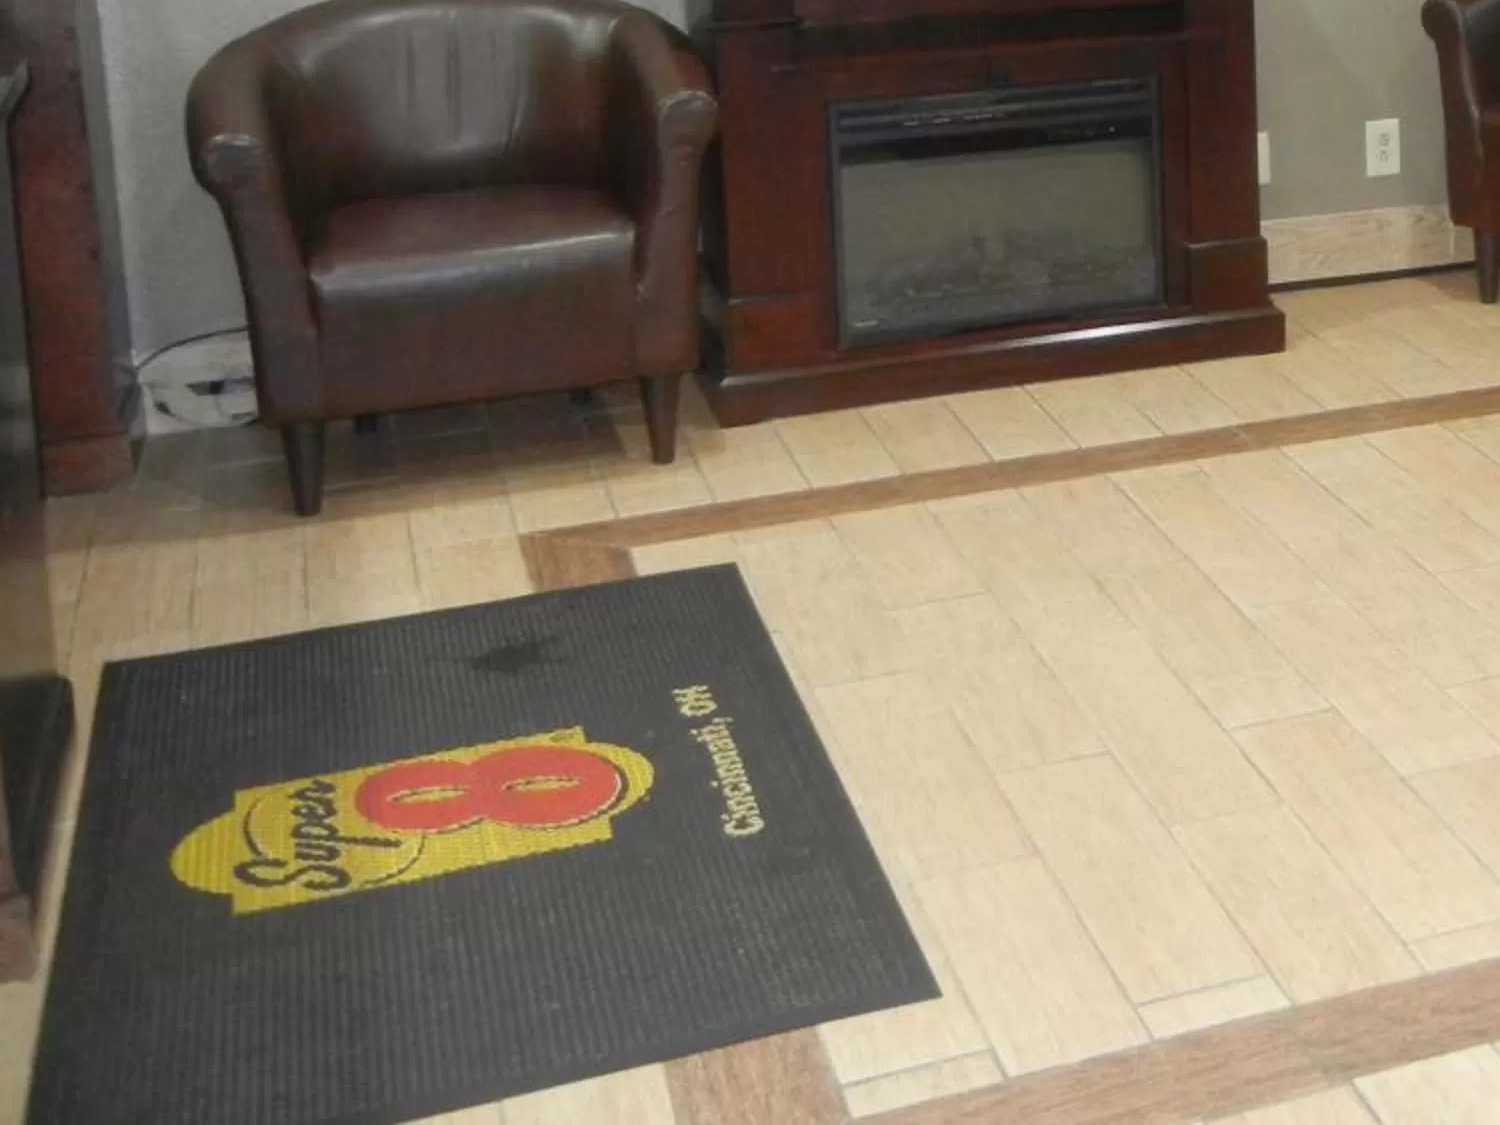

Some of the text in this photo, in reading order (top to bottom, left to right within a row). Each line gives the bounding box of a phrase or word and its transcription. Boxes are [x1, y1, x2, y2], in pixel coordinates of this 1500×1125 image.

[353, 744, 629, 838] 8
[671, 684, 765, 838] Cincinnati, OH
[232, 777, 403, 893] Super
